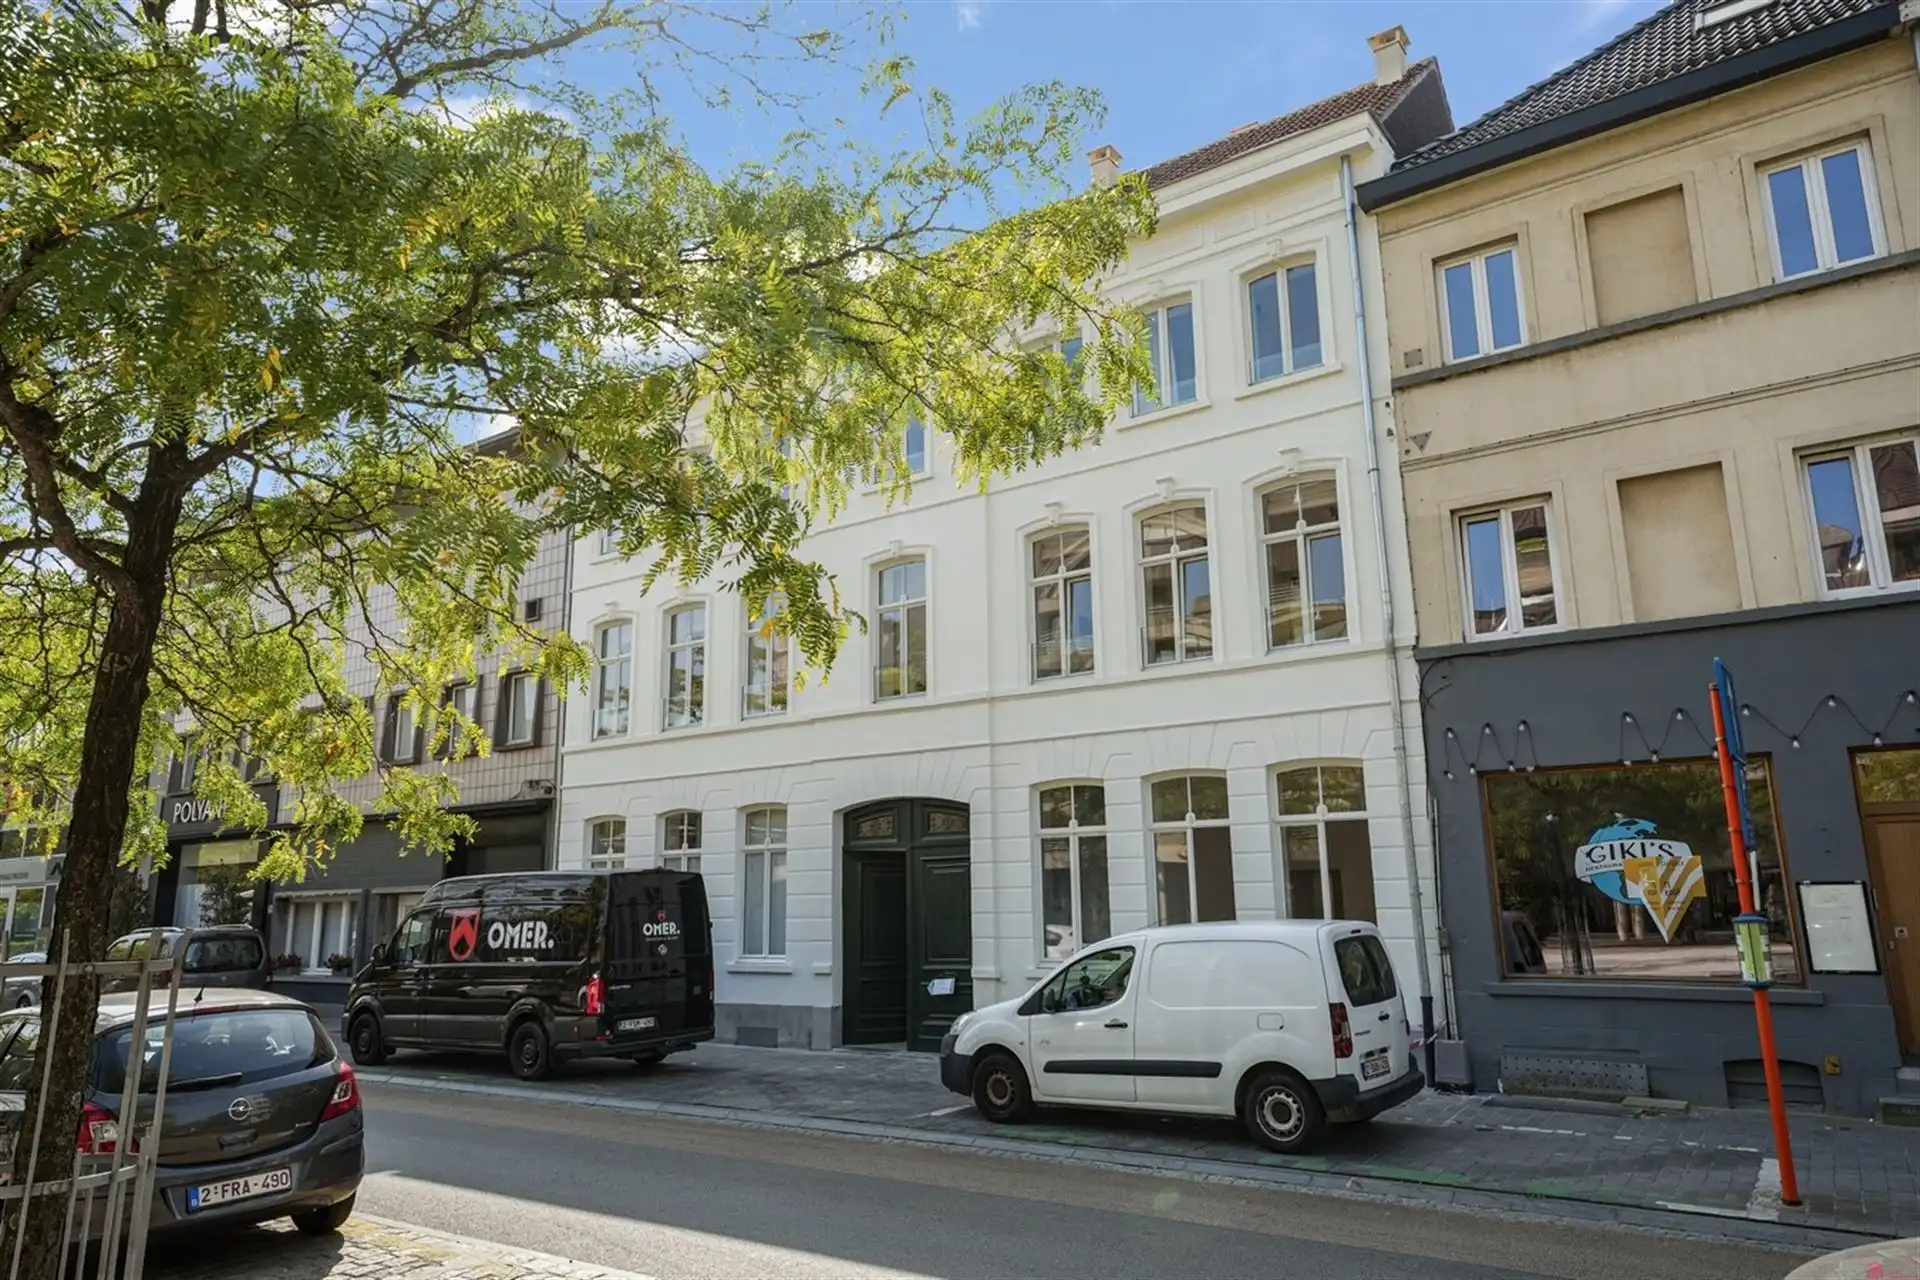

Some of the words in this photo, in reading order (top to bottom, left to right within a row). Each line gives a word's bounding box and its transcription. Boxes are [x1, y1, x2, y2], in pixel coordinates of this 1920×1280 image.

[1586, 842, 1676, 864] GIKI'S
[1585, 862, 1624, 873] RESTAURA
[487, 920, 554, 949] OMER.
[642, 921, 681, 936] OMER.
